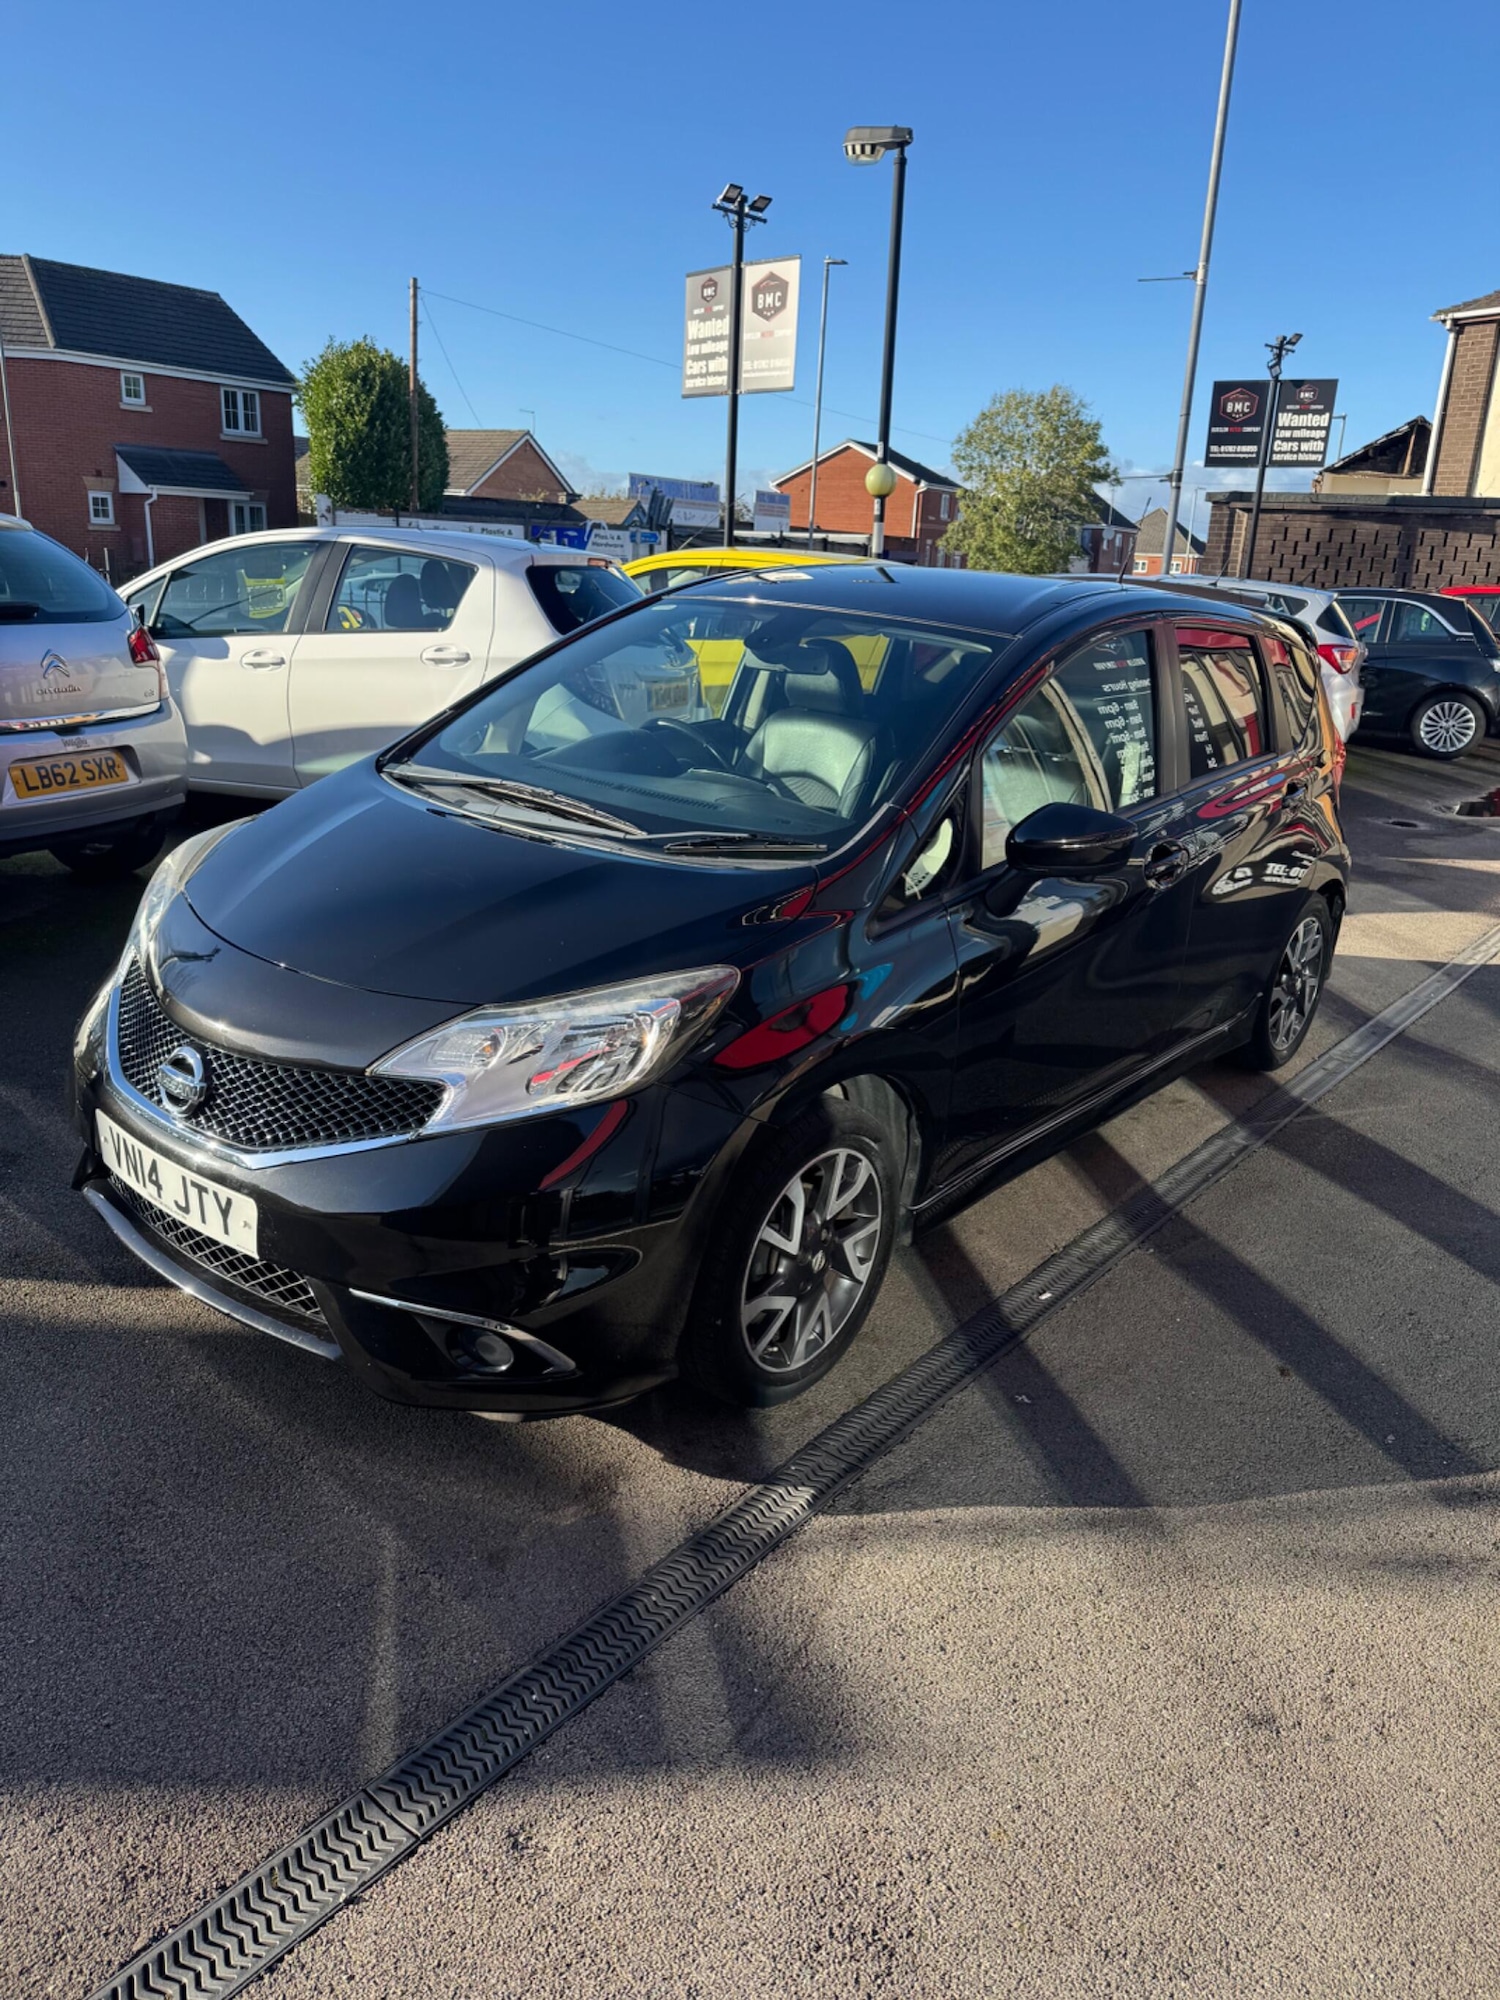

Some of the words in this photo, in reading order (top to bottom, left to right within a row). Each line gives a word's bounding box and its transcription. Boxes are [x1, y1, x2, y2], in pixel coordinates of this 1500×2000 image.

[757, 291, 782, 309] BMC
[687, 315, 730, 340] Wanted
[687, 343, 700, 355] Low
[700, 340, 728, 354] mileage
[686, 358, 707, 375] Cars
[707, 355, 728, 373] with
[1300, 391, 1315, 399] BMC
[1226, 402, 1251, 413] BMC
[1277, 412, 1330, 427] Wanted
[1275, 429, 1292, 438] Low
[1292, 428, 1327, 439] mileage
[1273, 440, 1299, 452] Cars
[1300, 440, 1325, 452] with
[1272, 453, 1297, 461] service
[1298, 453, 1323, 461] history
[480, 527, 506, 536] Plastic
[591, 541, 624, 549] Hardware
[21, 761, 80, 792] LB62
[81, 756, 120, 781] SXR
[109, 1126, 163, 1200] VN14
[174, 1175, 233, 1237] JTY
